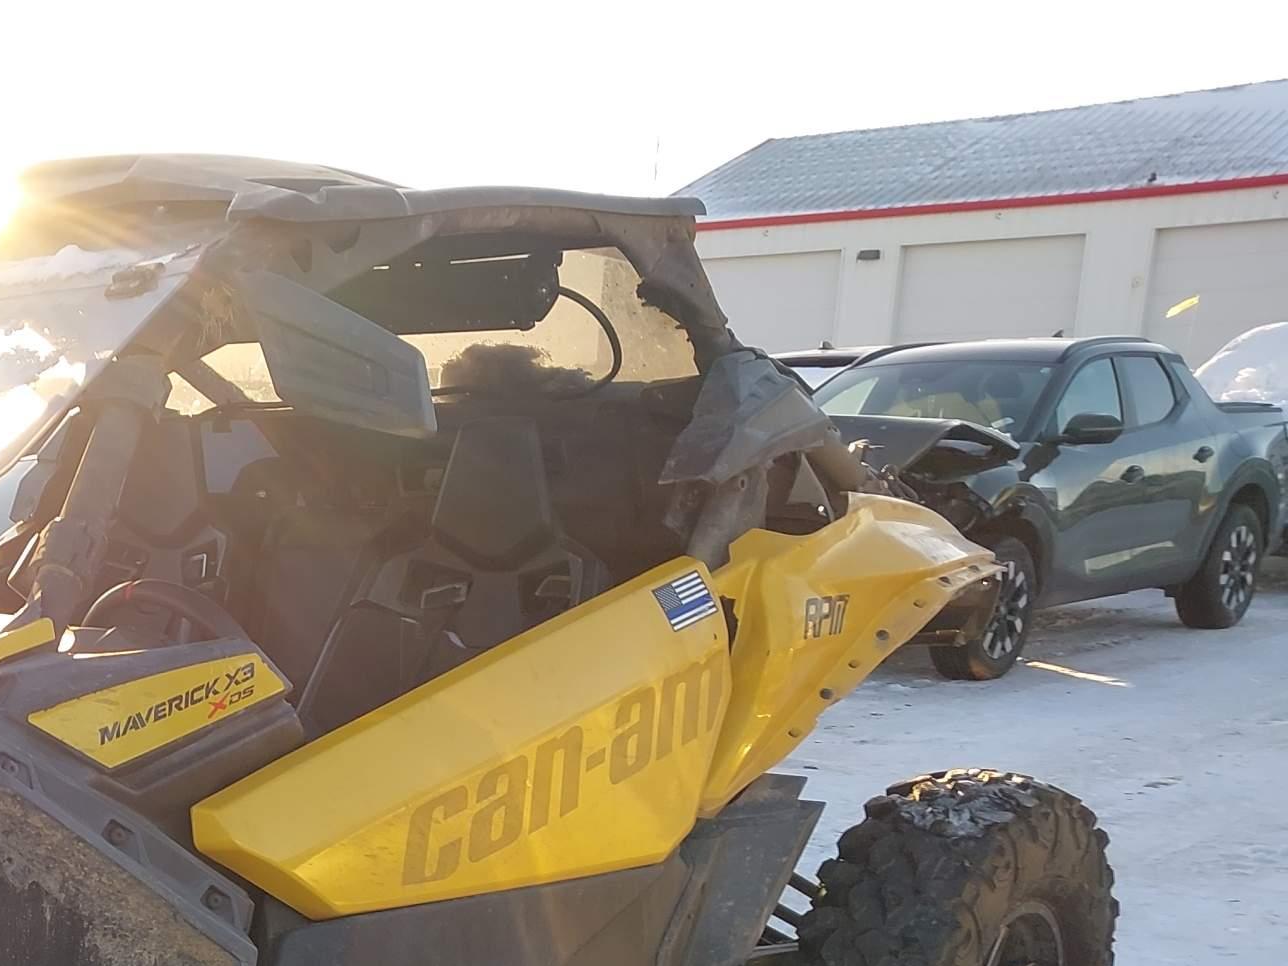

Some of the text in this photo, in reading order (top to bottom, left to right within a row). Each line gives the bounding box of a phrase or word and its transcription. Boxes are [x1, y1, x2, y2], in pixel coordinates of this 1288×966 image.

[98, 662, 255, 746] MAVERICK X3
[401, 651, 726, 887] can-am
